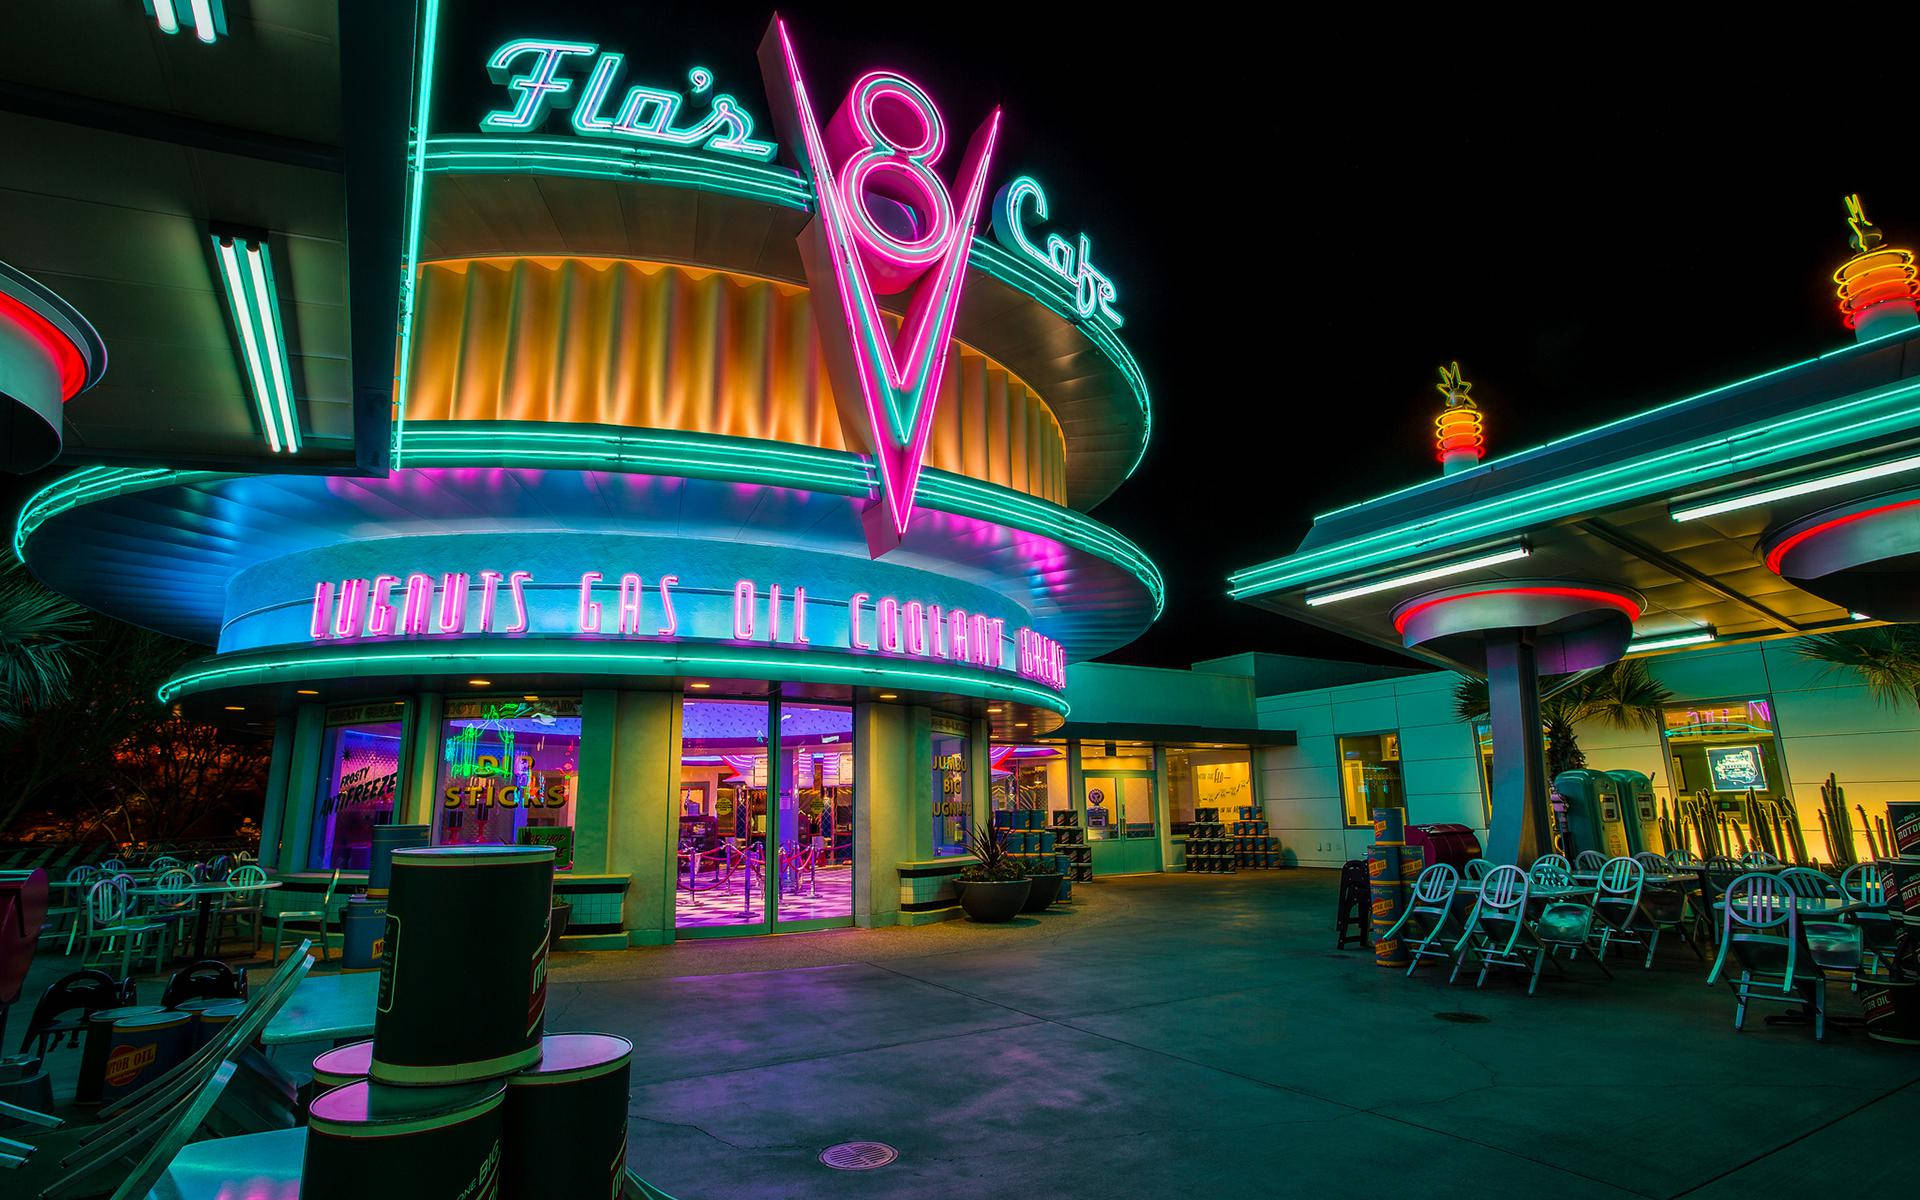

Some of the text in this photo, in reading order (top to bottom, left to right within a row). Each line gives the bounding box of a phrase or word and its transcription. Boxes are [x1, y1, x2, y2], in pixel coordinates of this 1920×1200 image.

[480, 38, 778, 163] Flo's
[310, 572, 534, 638] LUGNUTS
[579, 572, 680, 636] GAS
[733, 580, 809, 645] OIL
[850, 593, 1004, 668] COOLANT
[932, 755, 968, 773] JUMBO
[340, 766, 370, 788] FROSTY
[943, 778, 961, 794] BIG
[321, 772, 398, 817] ANTIFREEZE
[444, 785, 568, 809] STICKS
[133, 1048, 154, 1067] OIL
